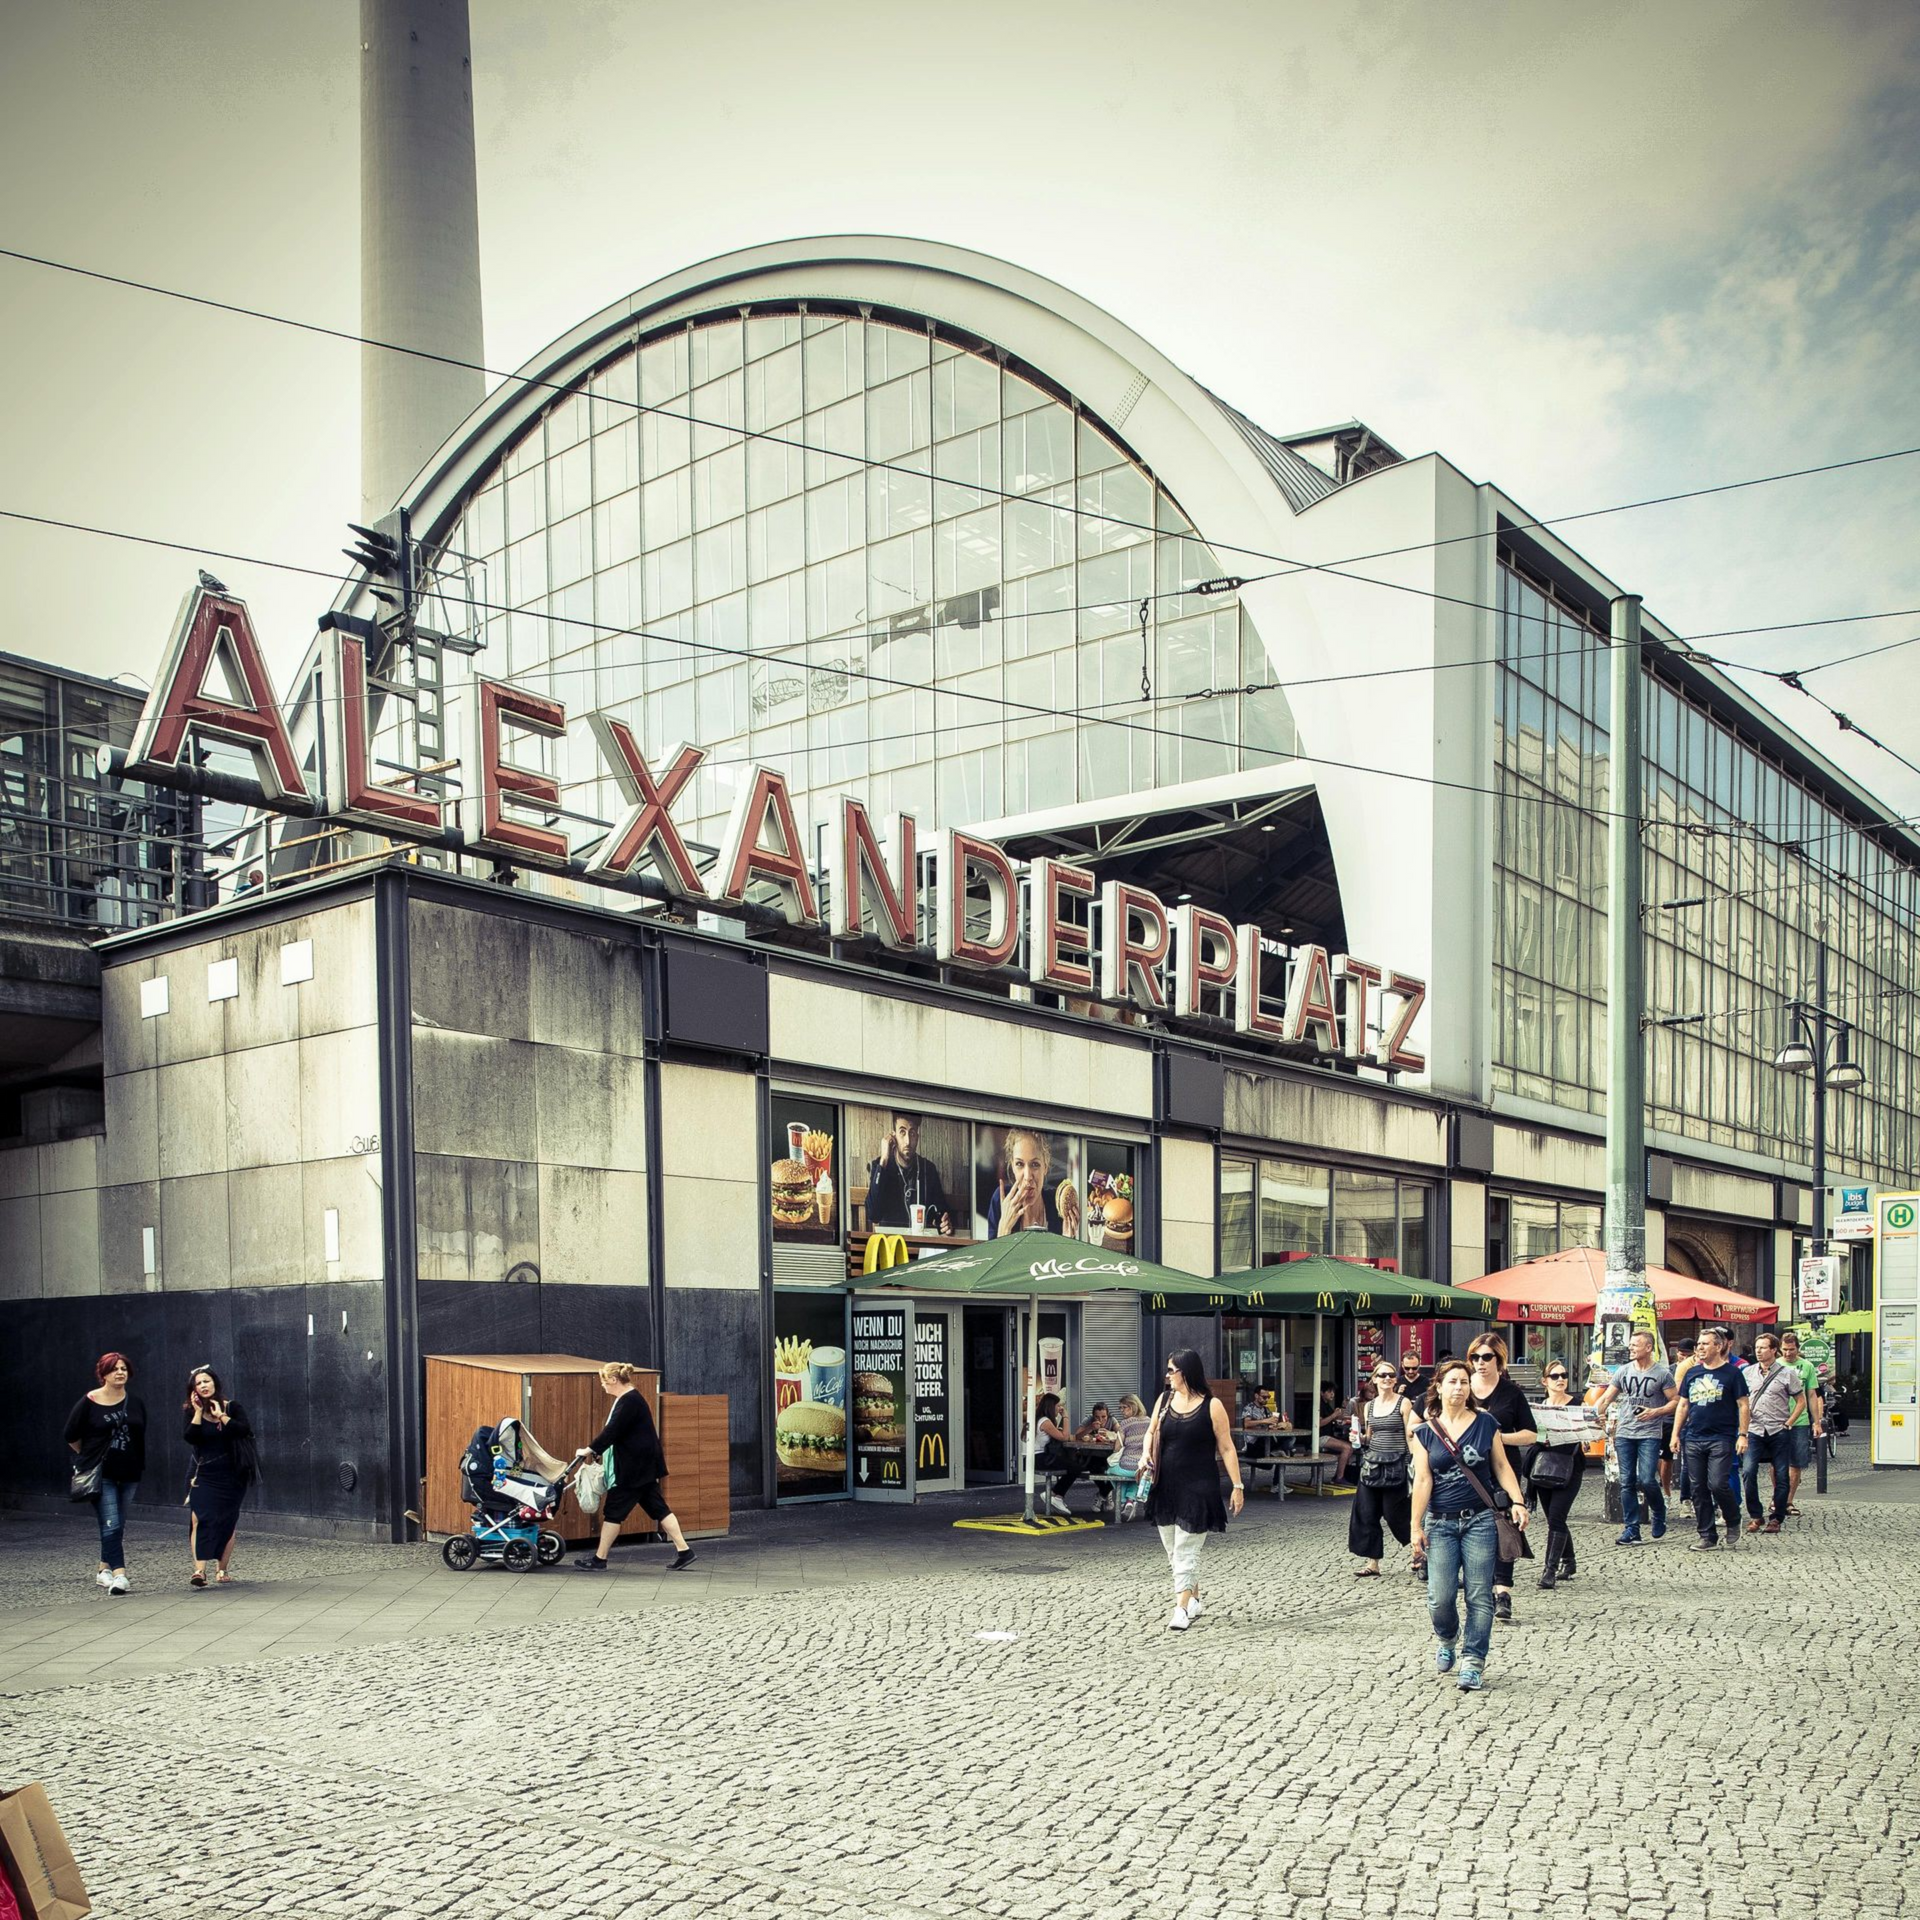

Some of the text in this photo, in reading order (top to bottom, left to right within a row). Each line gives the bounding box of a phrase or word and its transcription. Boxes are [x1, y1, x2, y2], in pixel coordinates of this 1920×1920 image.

[126, 585, 1426, 1073] ALEXANDERPLATZ
[1847, 1193, 1863, 1201] ibis
[1530, 1304, 1575, 1313] CURRYWURST
[1722, 1304, 1759, 1314] CURRYWURST
[853, 1316, 902, 1336] WENN DU
[854, 1339, 903, 1350] NOCH NACHSCHUB
[915, 1344, 942, 1362] INEN
[854, 1354, 903, 1371] BRAUCHST.
[915, 1364, 943, 1380] TOCK
[1622, 1376, 1657, 1398] NYC
